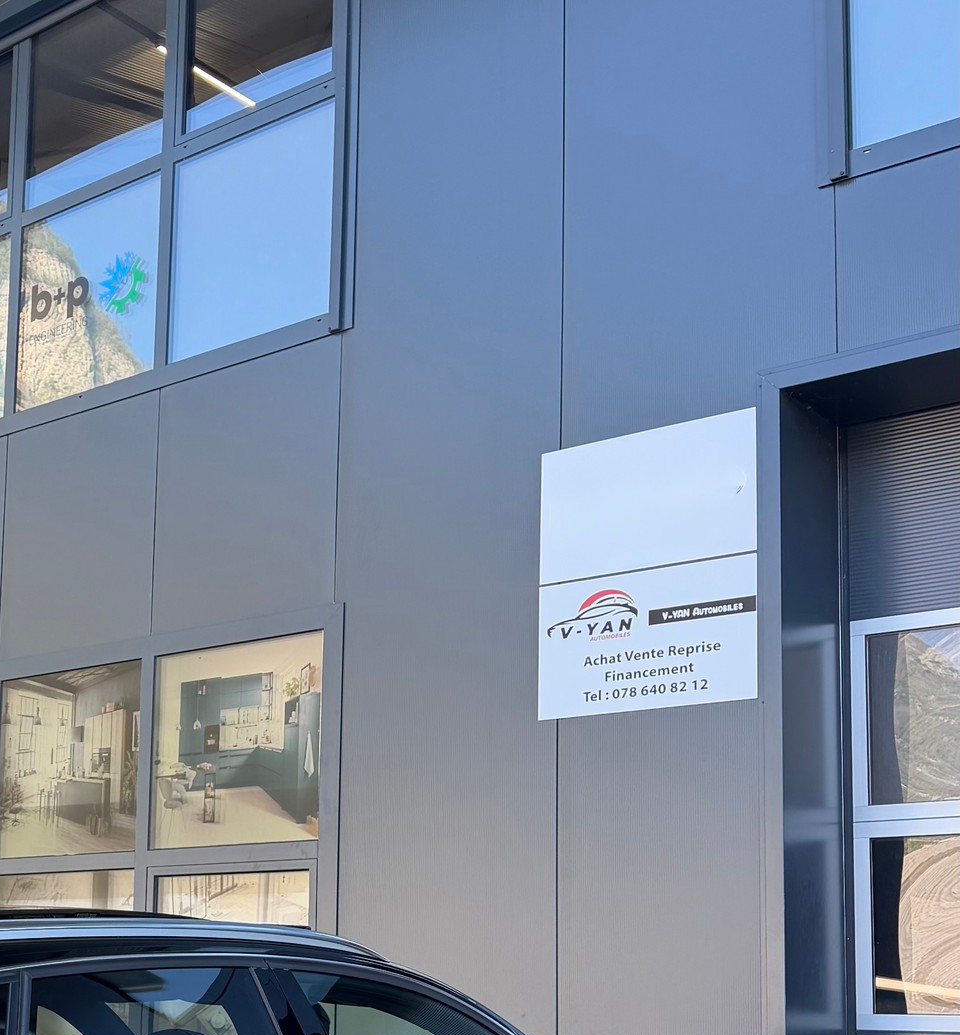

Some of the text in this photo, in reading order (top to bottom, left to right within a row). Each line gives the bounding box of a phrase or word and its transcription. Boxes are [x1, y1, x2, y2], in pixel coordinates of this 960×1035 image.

[30, 276, 90, 323] b+p
[661, 602, 744, 621] V-YAN AUTOMOBILES
[560, 617, 633, 640] V-YAN
[589, 631, 631, 642] AUTOMOBILES
[583, 640, 722, 667] Achat Vente Reprise
[604, 662, 695, 682] Financement
[612, 684, 638, 699] 078
[641, 683, 666, 697] 640
[670, 681, 687, 694] 82
[692, 678, 709, 691] 12
